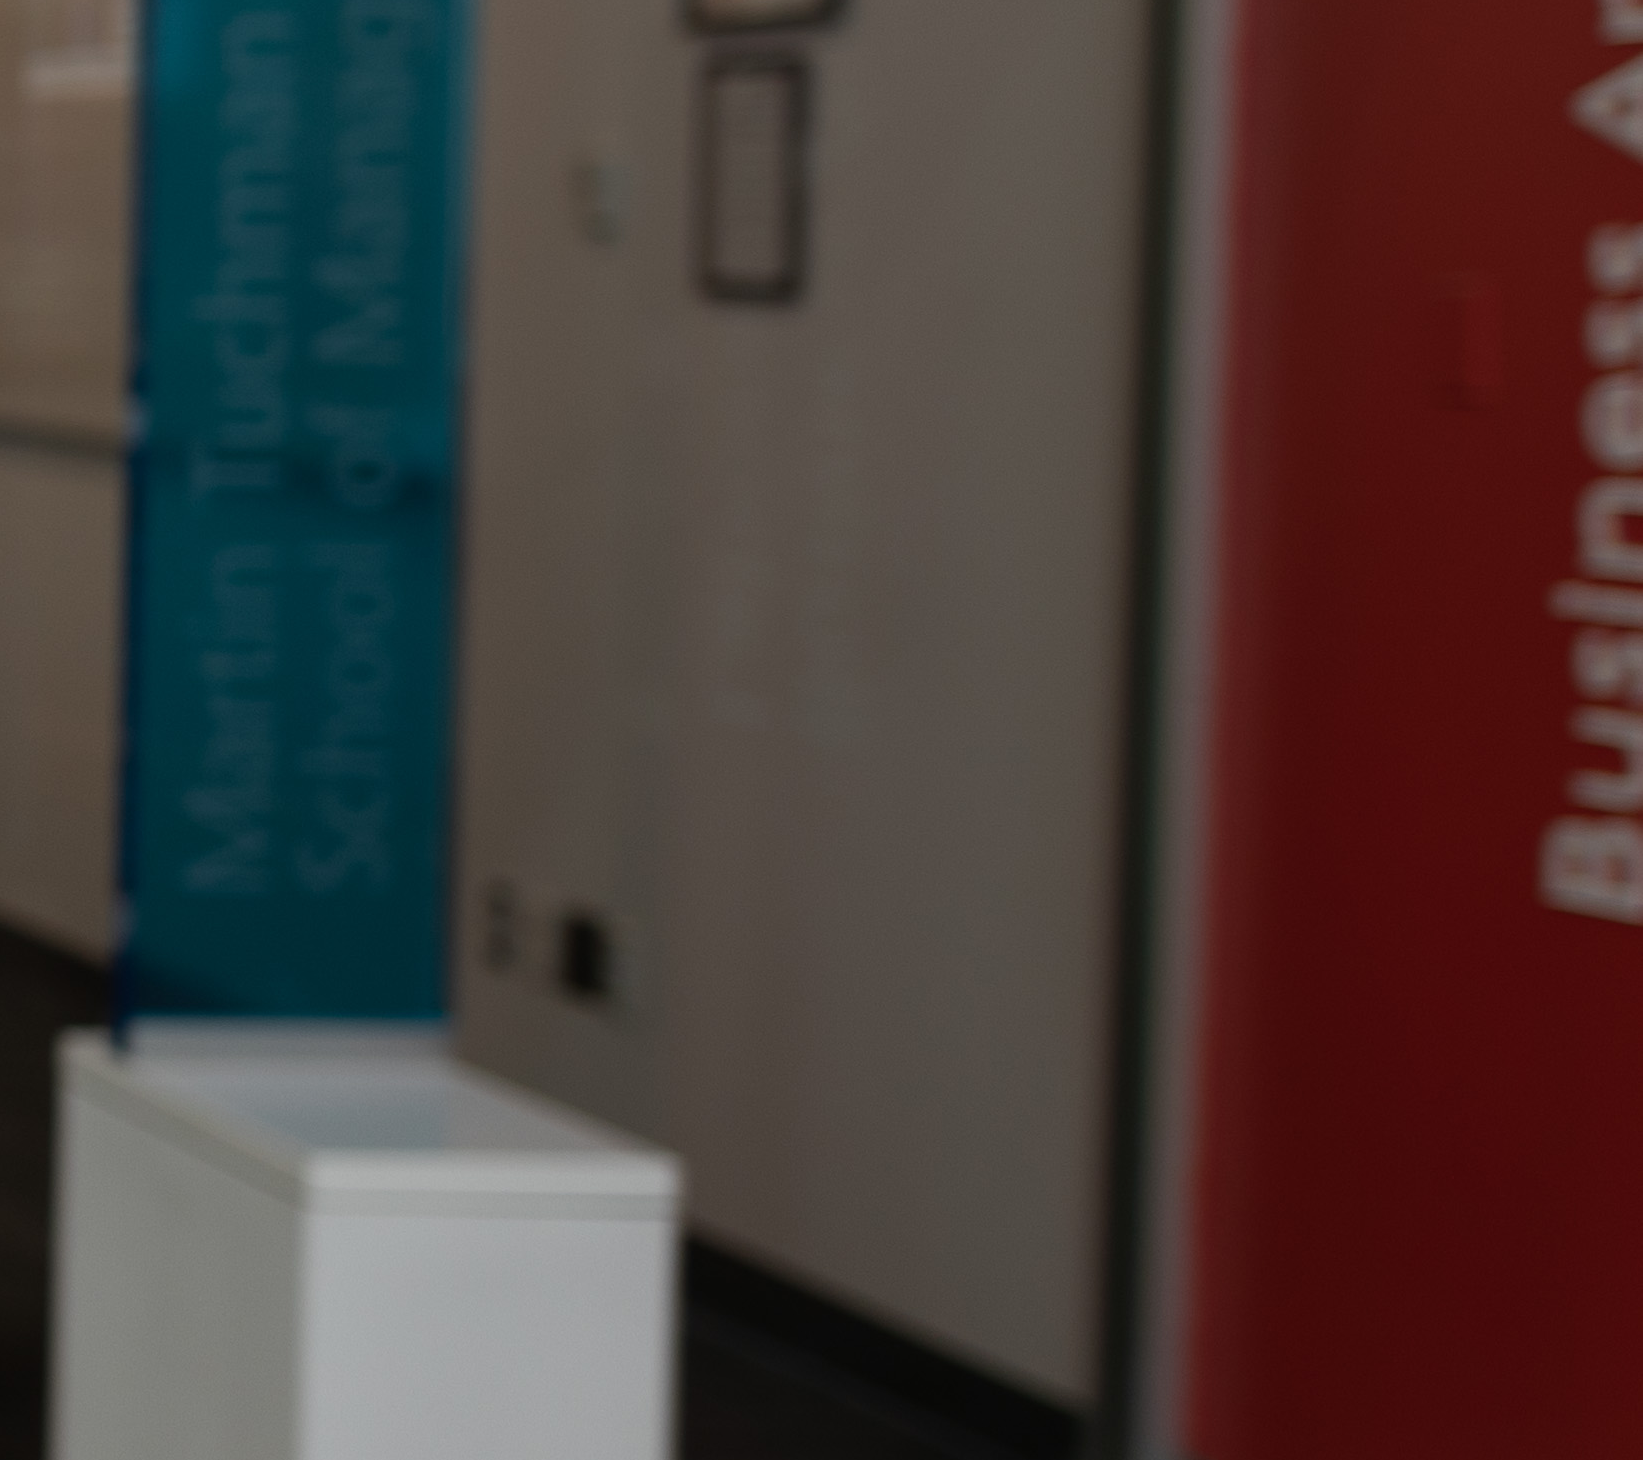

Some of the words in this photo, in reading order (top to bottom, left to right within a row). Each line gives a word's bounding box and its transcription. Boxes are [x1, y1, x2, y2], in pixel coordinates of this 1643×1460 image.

[190, 11, 297, 511] Tuchman
[306, 403, 401, 509] of
[181, 544, 276, 894] Martin
[293, 543, 399, 894] School
